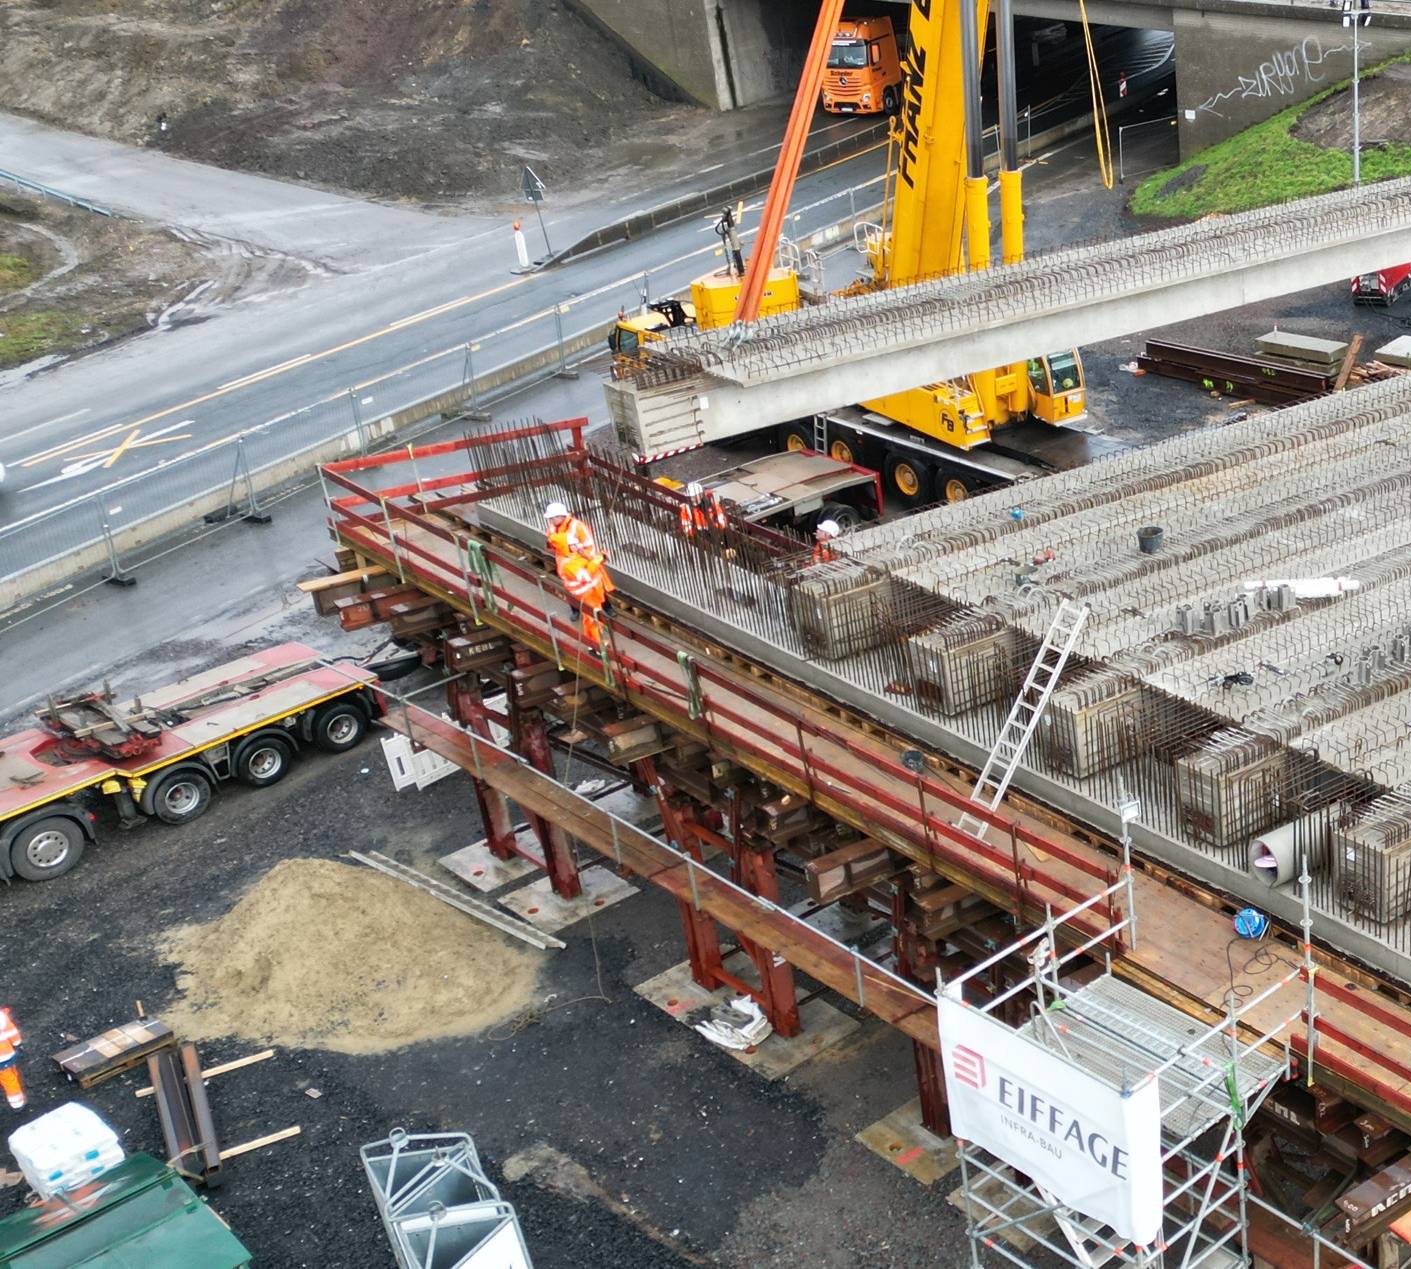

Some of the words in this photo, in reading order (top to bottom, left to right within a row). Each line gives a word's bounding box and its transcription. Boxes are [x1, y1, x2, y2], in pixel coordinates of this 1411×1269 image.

[899, 30, 926, 190] FRANZ
[999, 1076, 1129, 1181] EIFFAGE
[1000, 1114, 1063, 1160] INFRA-BAU
